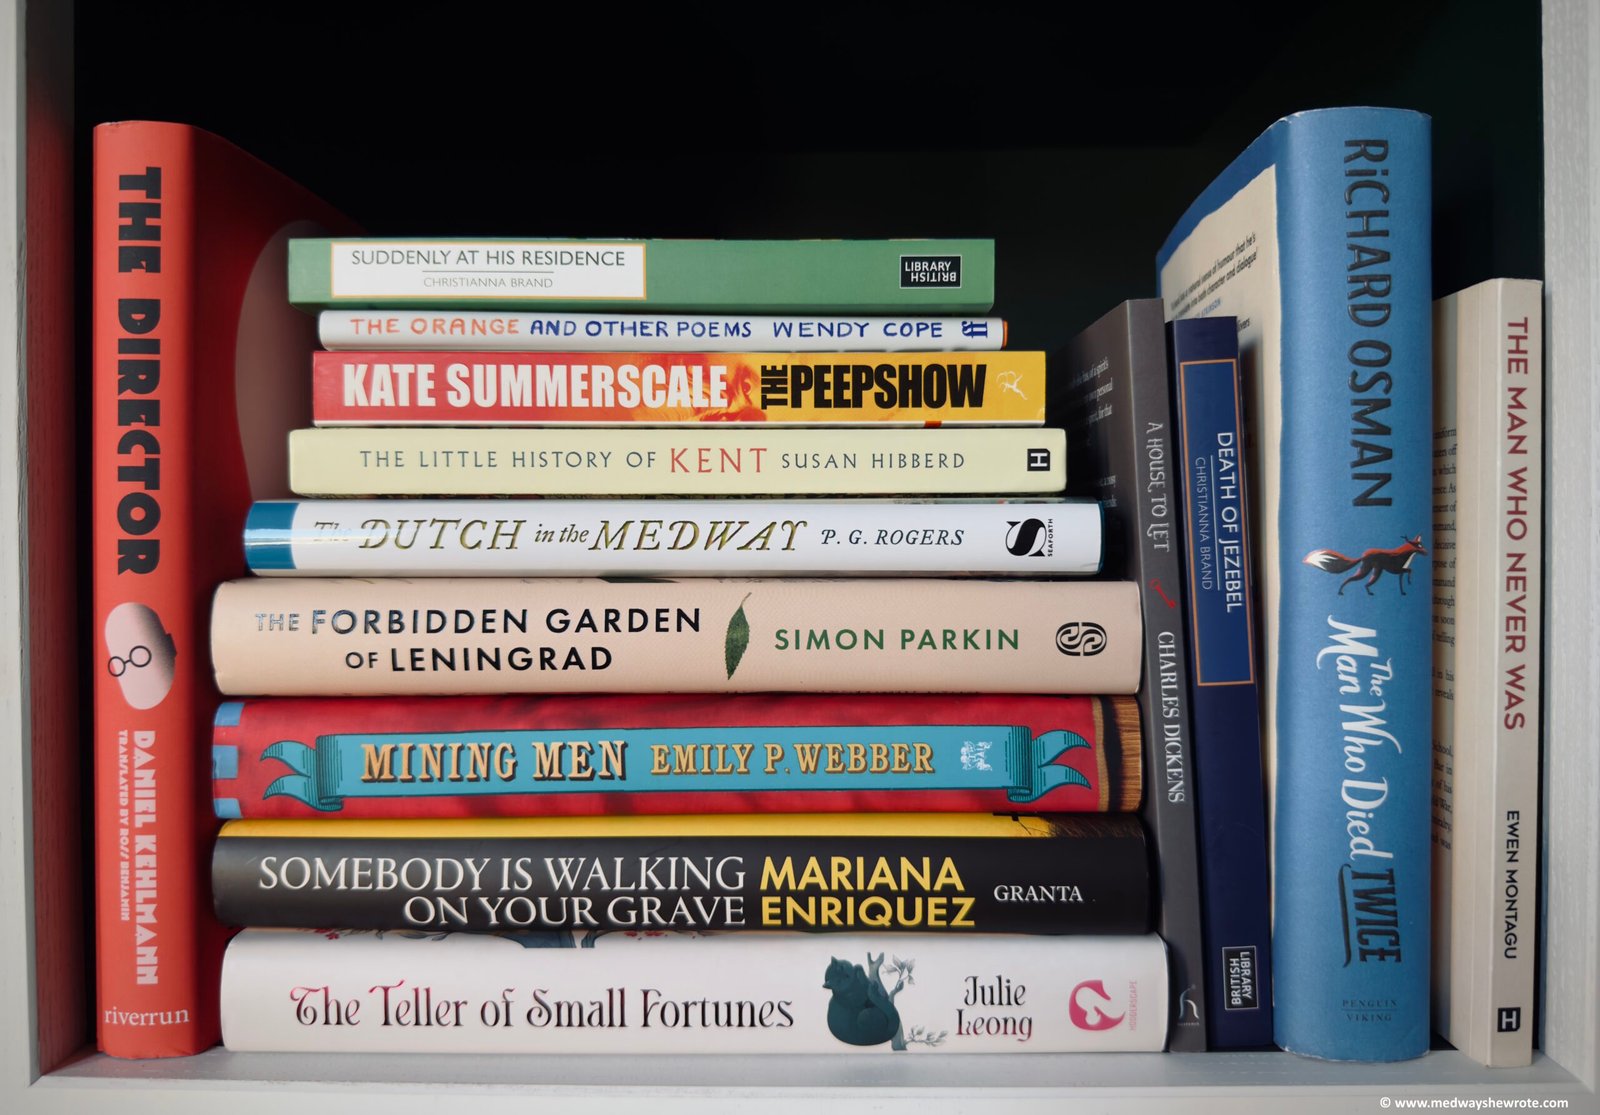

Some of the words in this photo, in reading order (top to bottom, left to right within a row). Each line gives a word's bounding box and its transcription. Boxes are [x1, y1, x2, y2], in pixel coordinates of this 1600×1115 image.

[118, 166, 162, 274] THE
[351, 249, 453, 267] SUDDENLY
[455, 250, 483, 266] AT
[486, 250, 518, 266] HIS
[522, 250, 625, 267] RESIDENCE
[904, 260, 952, 273] LIBRARY
[910, 271, 957, 283] BRITISH
[422, 276, 507, 289] CHRISTIANNA
[510, 277, 553, 289] BRAND
[350, 318, 402, 336] THE
[410, 318, 520, 336] ORANGE
[530, 319, 577, 337] AND
[585, 320, 669, 338] OTHER
[677, 320, 752, 338] POEMS
[772, 321, 870, 339] WENDY
[882, 321, 943, 338] COPE
[1507, 316, 1529, 375] THE
[343, 364, 436, 408] KATE
[446, 363, 728, 409] SUMMERSCALE
[760, 364, 789, 410] THE
[790, 363, 987, 410] PEEPSHOW
[117, 298, 161, 576] DIRECTOR
[1146, 422, 1163, 434] A
[1348, 339, 1393, 507] OSMAN
[1507, 387, 1528, 455] MAN
[360, 450, 405, 468] THE
[419, 450, 498, 468] LITTLE
[511, 450, 613, 469] HISTORY
[625, 450, 657, 468] OF
[669, 447, 768, 475] KENT
[781, 453, 858, 470] SUSAN
[872, 452, 966, 469] HIBBERD
[1145, 438, 1166, 493] HOUSE
[1217, 432, 1236, 500] DEATH
[1151, 495, 1168, 516] TO
[1194, 456, 1210, 543] CHRISTIANNA
[1221, 506, 1239, 533] OF
[1506, 466, 1528, 541] WHO
[357, 517, 527, 551] DUTCH
[535, 523, 555, 543] in
[557, 522, 588, 544] the
[588, 518, 808, 552] MEDWAY
[820, 528, 840, 546] P.
[848, 529, 868, 546] G.
[875, 528, 965, 547] ROGERS
[1046, 517, 1054, 558] SEAFORTH
[1146, 522, 1170, 553] LET
[1200, 546, 1213, 590] BRAND
[1218, 538, 1243, 614] JEZEBEL
[255, 612, 300, 632] THE
[311, 609, 528, 635] FORBIDDEN
[545, 607, 701, 634] GARDEN
[1505, 552, 1527, 654] NEVER
[345, 651, 379, 669] OF
[391, 646, 613, 672] LENINGRAD
[774, 629, 885, 651] SIMON
[900, 628, 1020, 651] PARKIN
[1315, 614, 1379, 696] Man
[1157, 631, 1180, 718] CHARLES
[1369, 657, 1394, 697] The
[1503, 664, 1526, 731] WAS
[1338, 699, 1403, 774] Who
[118, 729, 129, 807] TRANSLATED
[133, 730, 157, 829] DANIEL
[360, 741, 518, 783] MINING
[532, 740, 629, 780] MEN
[650, 742, 754, 775] EMILY
[1164, 722, 1185, 803] DICKENS
[120, 810, 130, 827] BY
[1340, 776, 1394, 861] Died
[1506, 810, 1520, 863] EWEN
[120, 829, 130, 858] ROSS
[120, 861, 131, 921] BENJAMIN
[259, 856, 491, 892] SOMEBODY
[500, 857, 533, 891] IS
[544, 856, 746, 891] WALKING
[759, 855, 966, 892] MARIANA
[993, 884, 1084, 903] GRANTA
[134, 834, 159, 985] KEHLMANN
[404, 896, 469, 926] ON
[480, 896, 600, 926] YOUR
[606, 895, 746, 926] GRAVE
[761, 896, 976, 928] ENRIQUEZ
[1350, 867, 1402, 964] TWICE
[1504, 869, 1519, 960] MONTAGU
[963, 975, 1026, 1007] Julie
[1229, 957, 1242, 1006] BRITISH
[1240, 951, 1253, 1000] LIBRARY
[104, 1006, 190, 1027] riverrun
[289, 985, 361, 1027] The
[368, 979, 468, 1028] Teller
[480, 988, 516, 1028] of
[526, 987, 627, 1029] Small
[640, 988, 795, 1029] Fortunes
[1342, 999, 1398, 1008] PENGUIN
[1346, 1013, 1393, 1022] VIKING
[955, 1008, 1033, 1043] Leong
